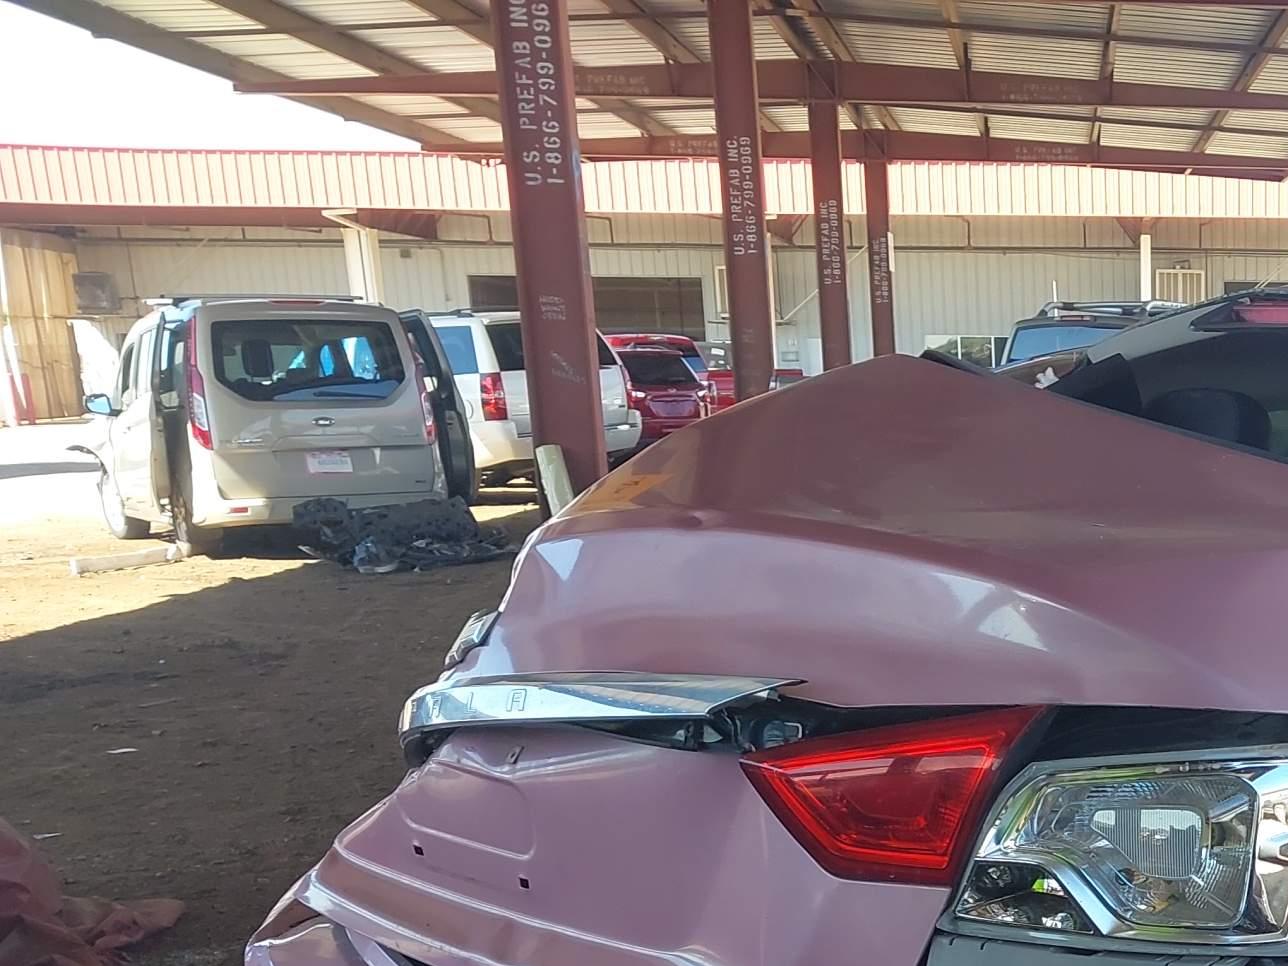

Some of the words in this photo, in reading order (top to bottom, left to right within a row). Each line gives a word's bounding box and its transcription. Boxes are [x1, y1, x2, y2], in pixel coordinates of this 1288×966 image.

[512, 41, 538, 130] PREFAB
[522, 144, 542, 186] U.S.
[728, 168, 744, 222] PREFAB
[733, 229, 746, 256] U.S.
